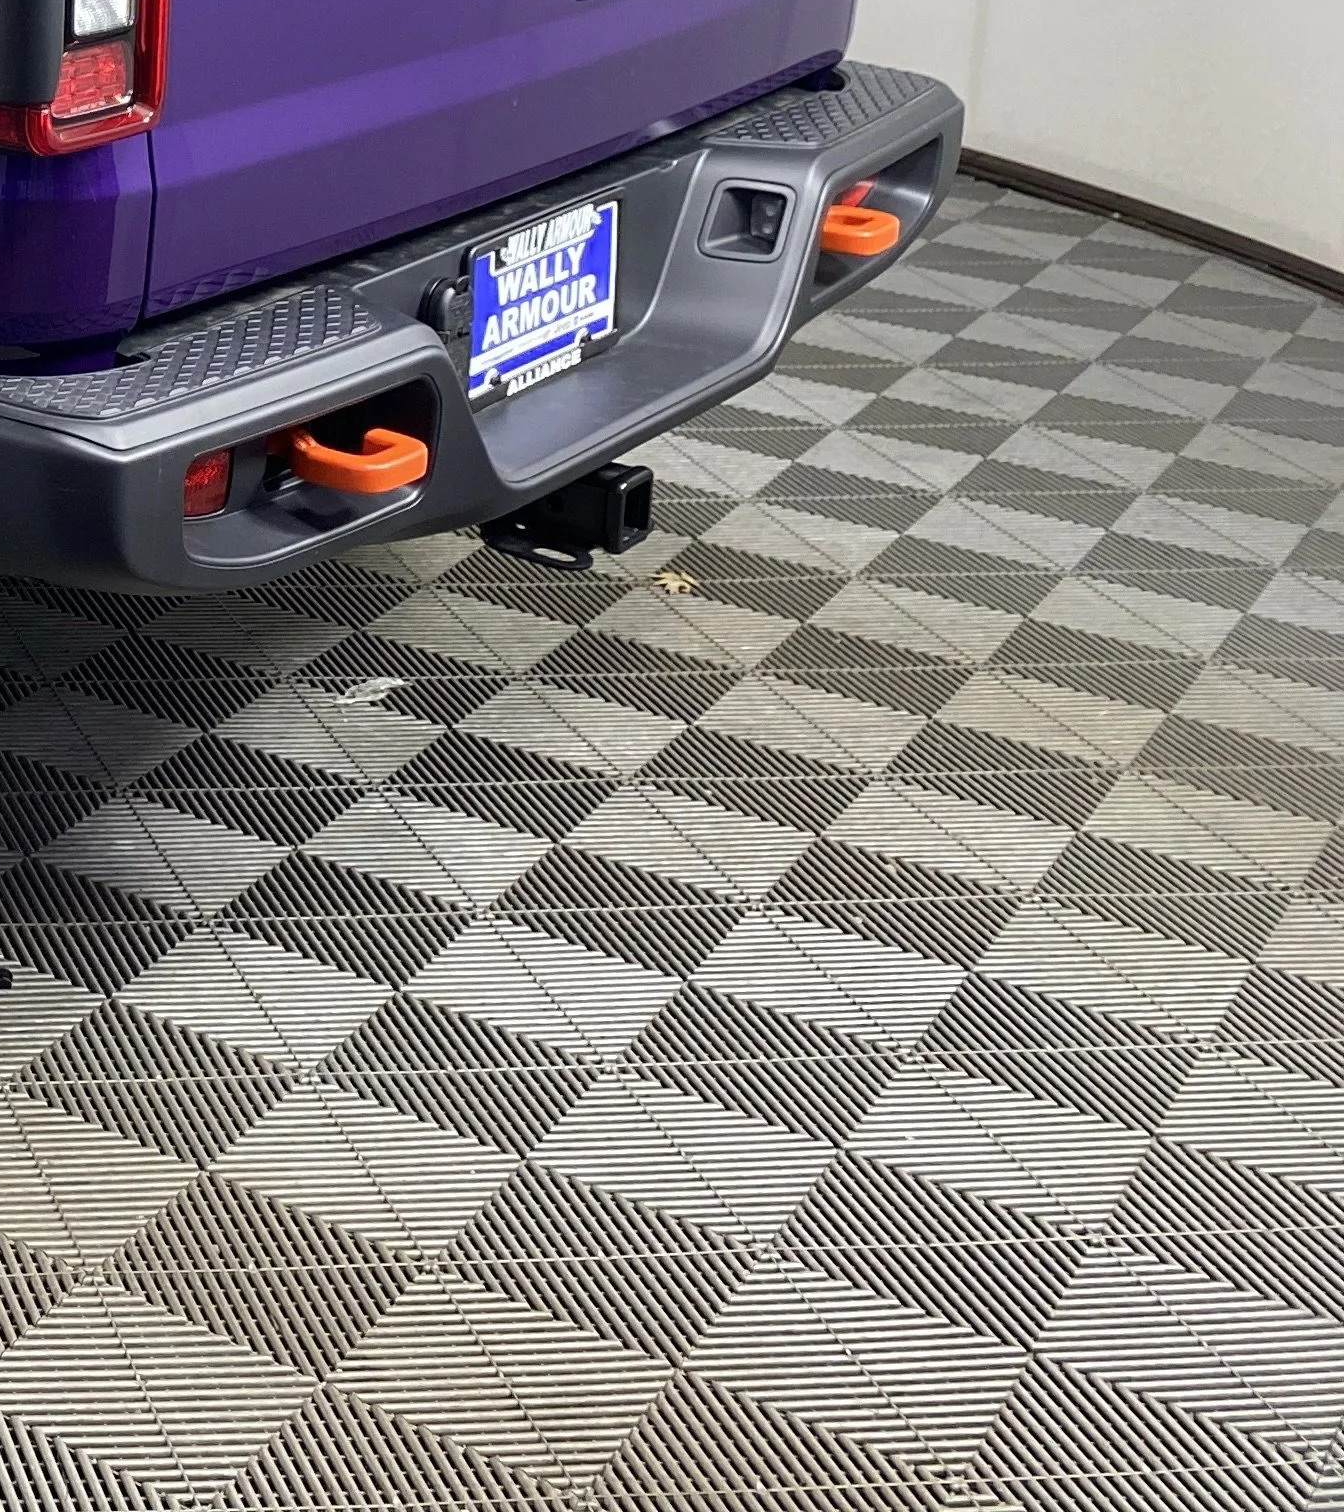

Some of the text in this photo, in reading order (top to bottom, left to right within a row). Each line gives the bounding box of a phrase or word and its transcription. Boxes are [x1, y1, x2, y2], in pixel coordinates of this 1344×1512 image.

[506, 204, 595, 265] WALLY ARMOUR
[497, 241, 587, 306] WALLY
[482, 273, 597, 351] ARMOUR
[506, 348, 582, 397] ALLIANCE
